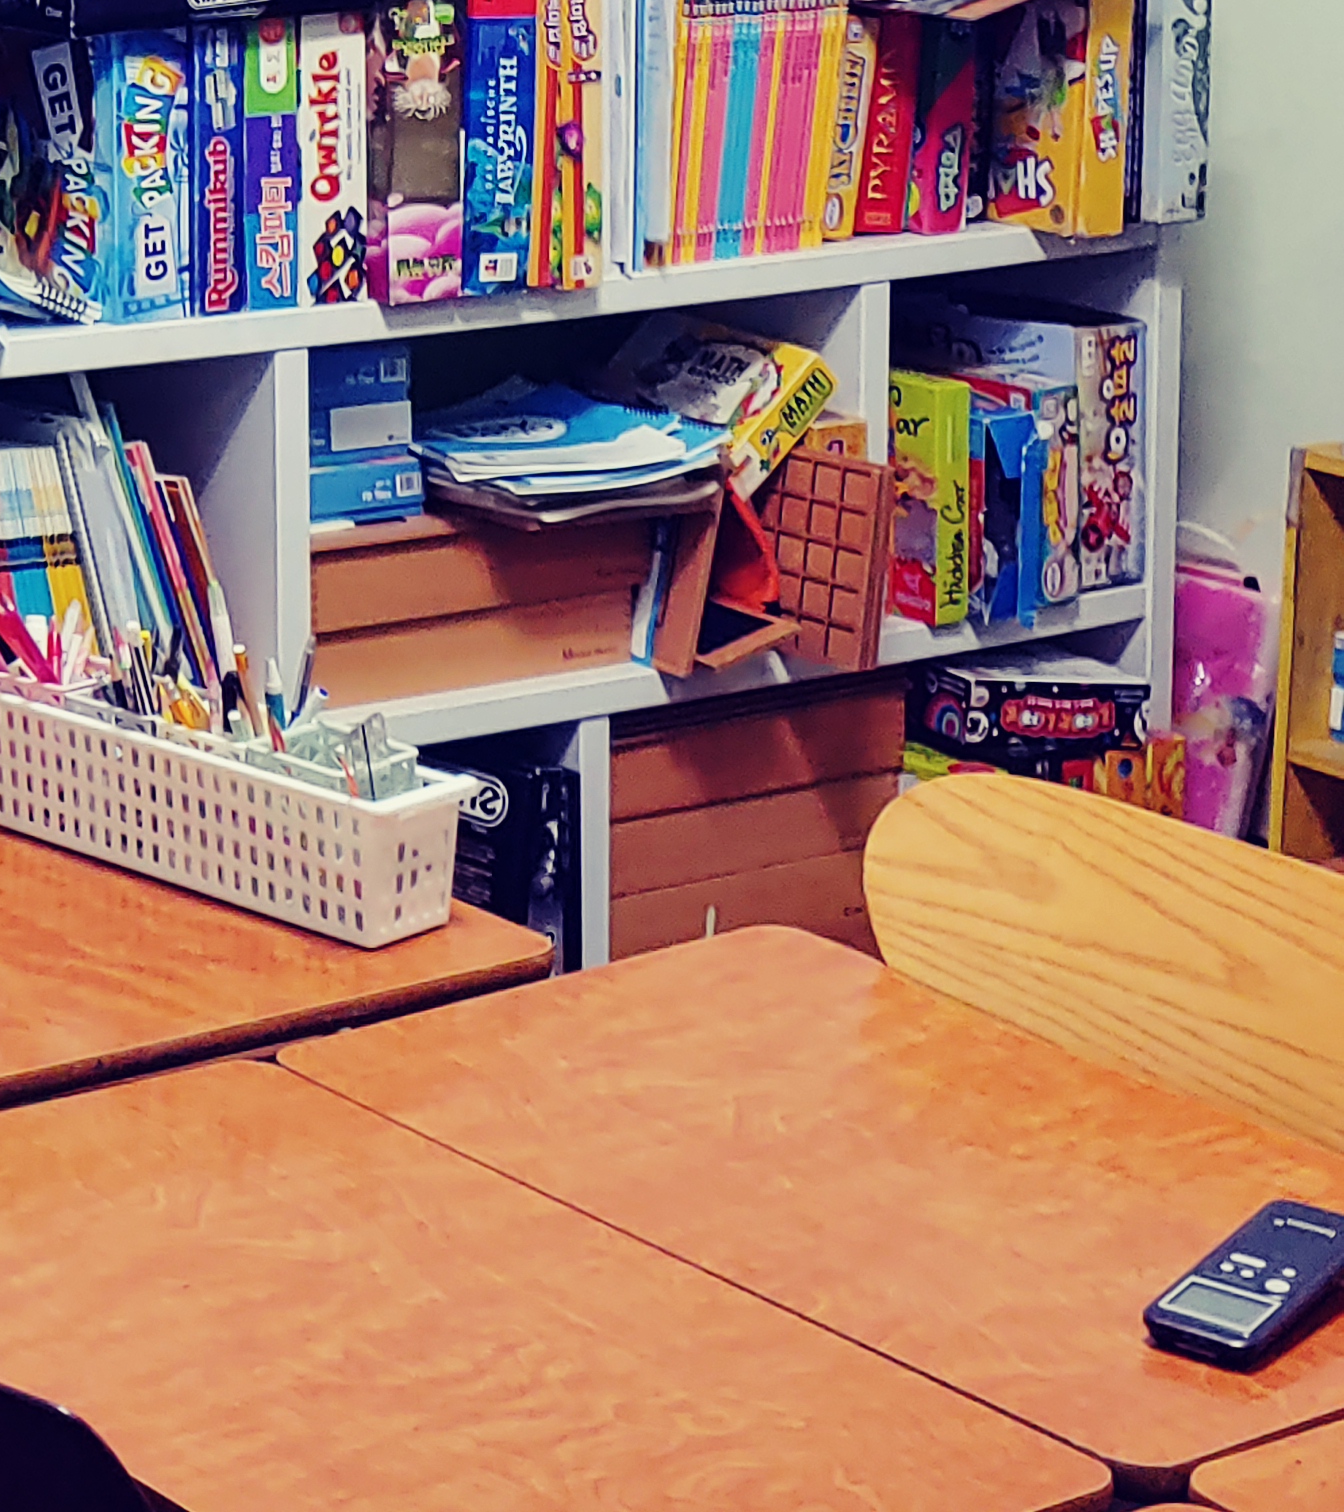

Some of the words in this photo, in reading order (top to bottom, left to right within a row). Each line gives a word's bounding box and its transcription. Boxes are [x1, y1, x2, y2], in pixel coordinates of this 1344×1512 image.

[43, 61, 78, 138] GET
[125, 58, 178, 210] PACKING
[308, 49, 341, 203] Qwirkle
[495, 55, 519, 207] LABYRINTH
[145, 222, 169, 283] GET
[206, 135, 238, 313] Rummikub
